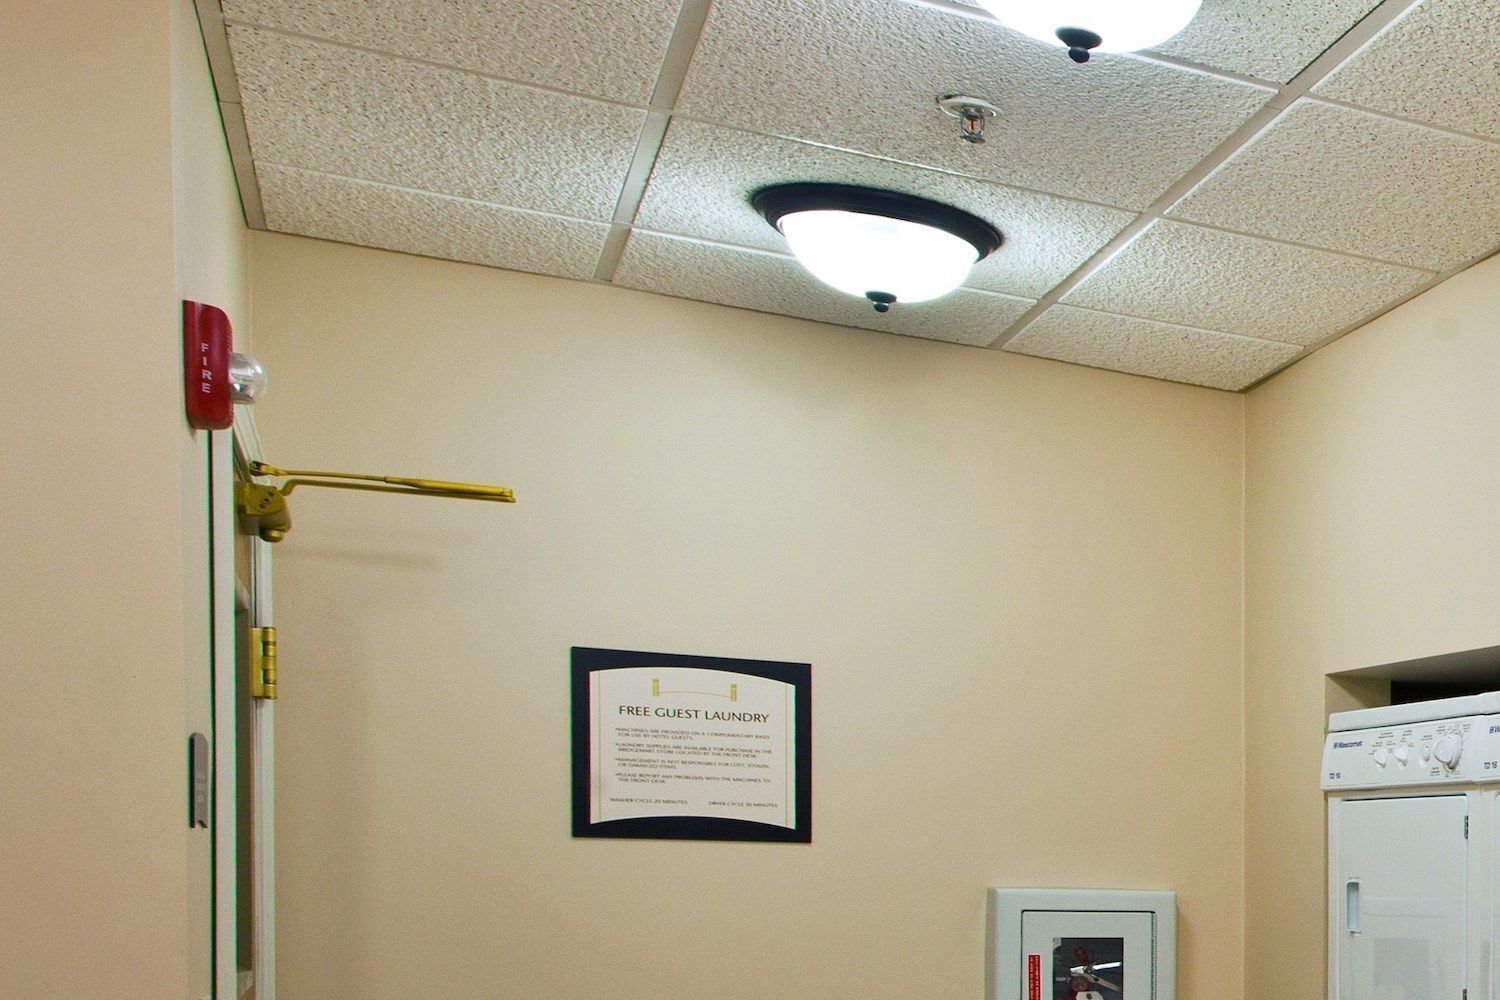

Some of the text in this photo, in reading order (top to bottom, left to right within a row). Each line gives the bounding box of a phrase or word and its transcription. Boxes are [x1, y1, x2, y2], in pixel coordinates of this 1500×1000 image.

[201, 342, 212, 394] FIRE
[619, 706, 769, 722] FREE GUEST LAUNDRY
[1338, 740, 1363, 748] Wascomat
